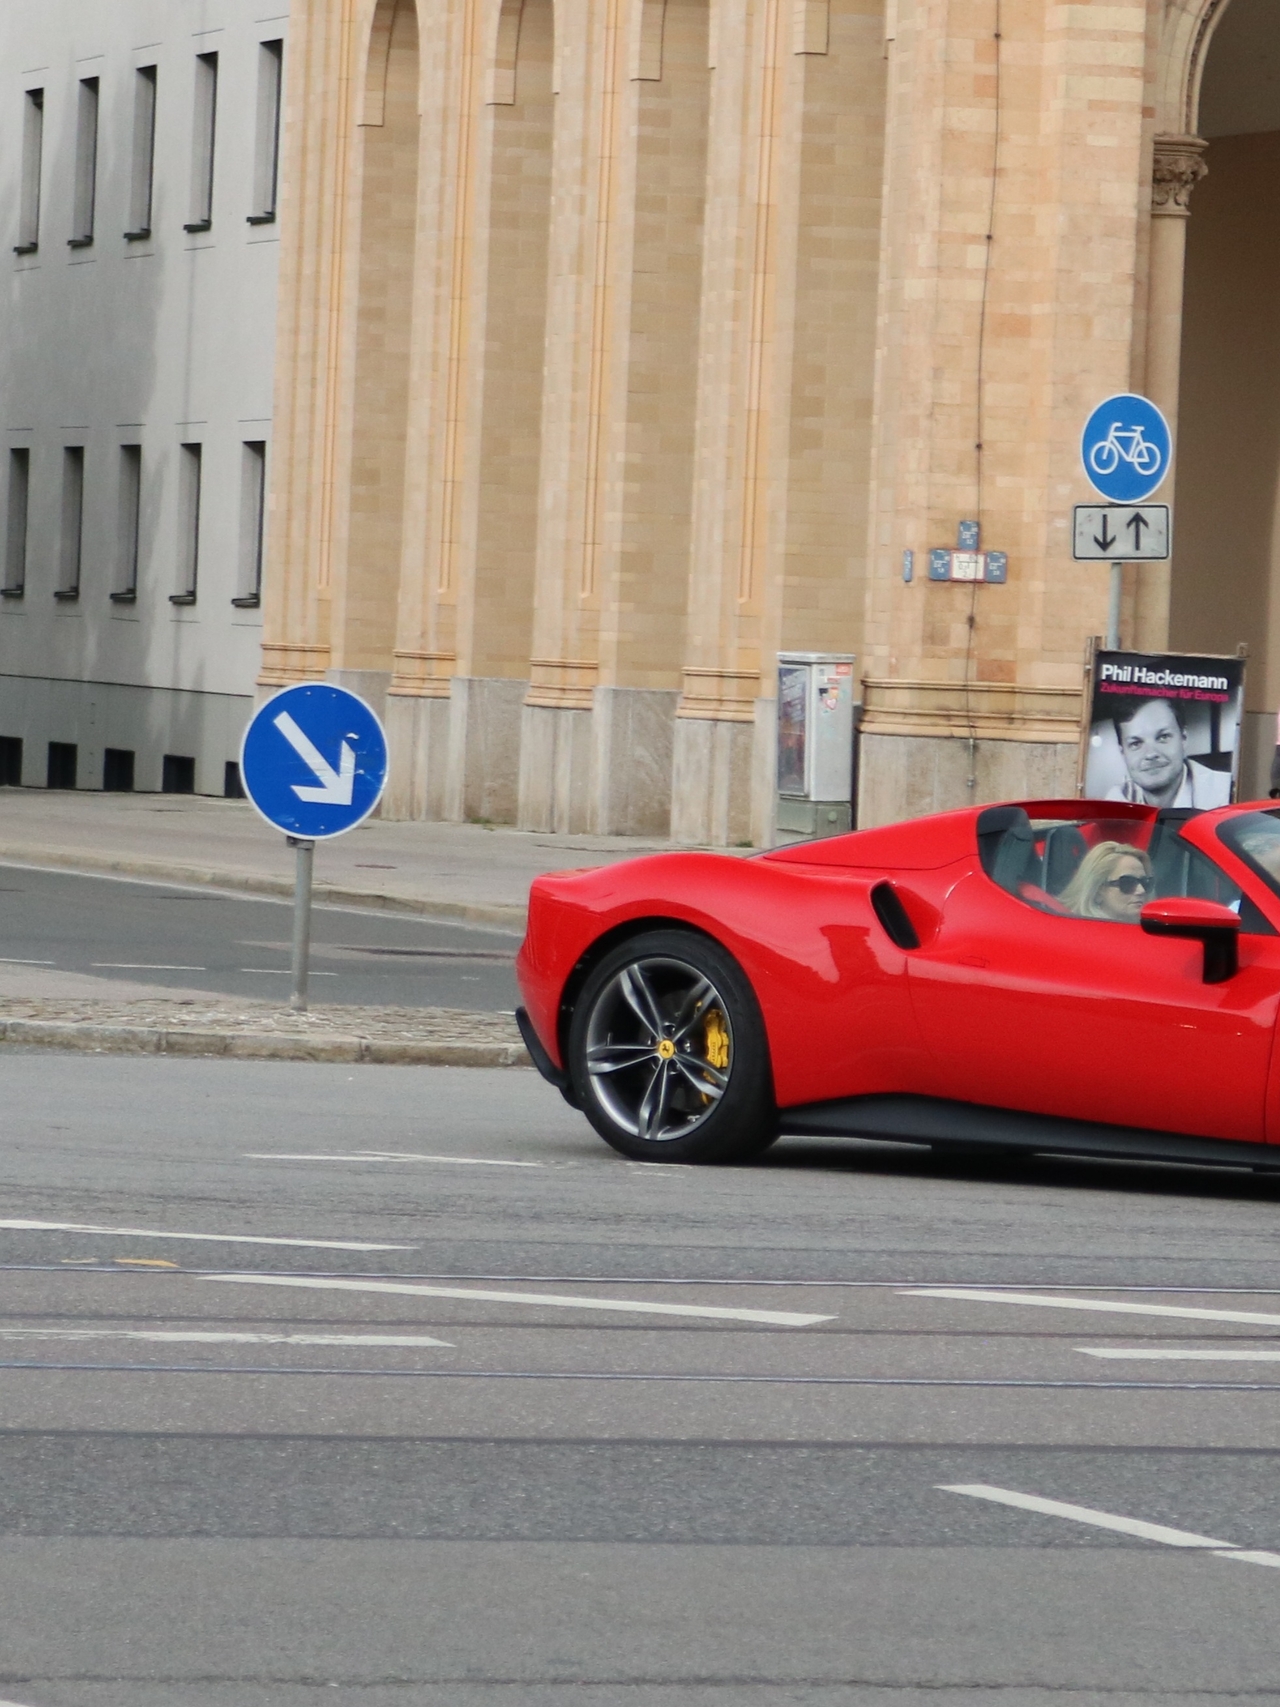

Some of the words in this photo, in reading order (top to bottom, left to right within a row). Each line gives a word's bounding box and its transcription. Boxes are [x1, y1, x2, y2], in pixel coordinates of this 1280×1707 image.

[1101, 664, 1132, 682] Phil
[1133, 667, 1228, 690] Hackemann
[1100, 683, 1178, 698] Zukunftsmacher
[1195, 690, 1228, 702] Europa
